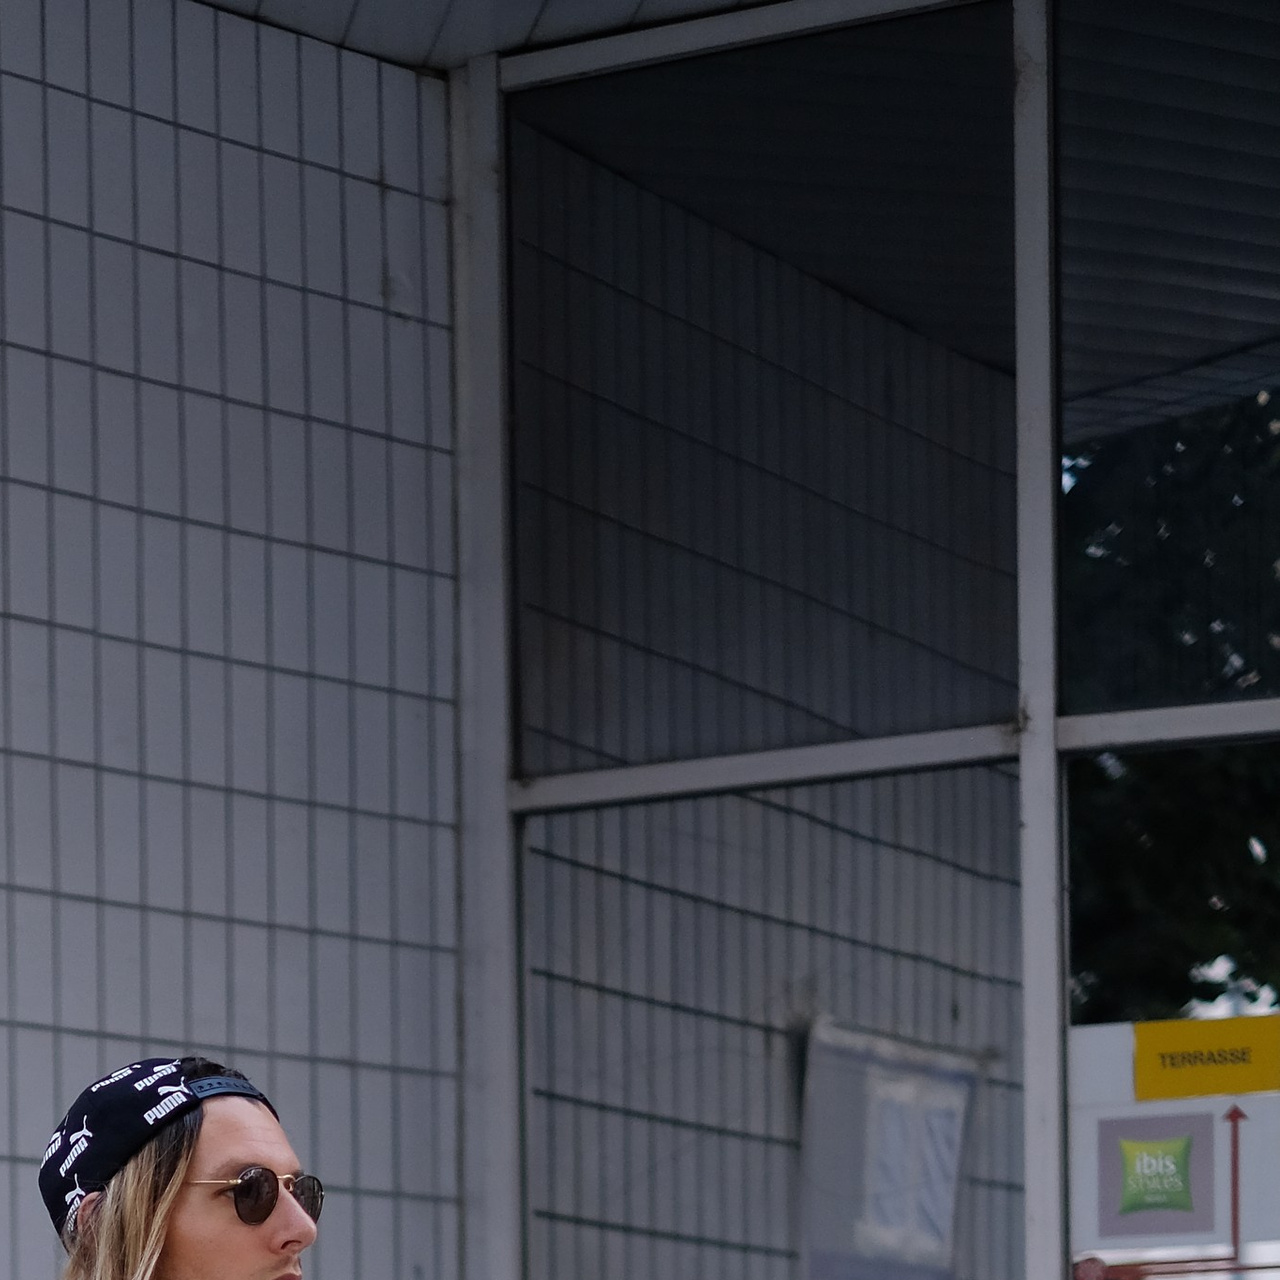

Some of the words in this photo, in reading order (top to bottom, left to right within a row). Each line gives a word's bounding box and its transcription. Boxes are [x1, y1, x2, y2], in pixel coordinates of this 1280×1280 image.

[1159, 1047, 1252, 1068] TERRASSE
[134, 1065, 177, 1091] PUMA
[143, 1092, 187, 1125] PUMA
[59, 1136, 88, 1177] PUMA
[1135, 1151, 1177, 1176] ibis
